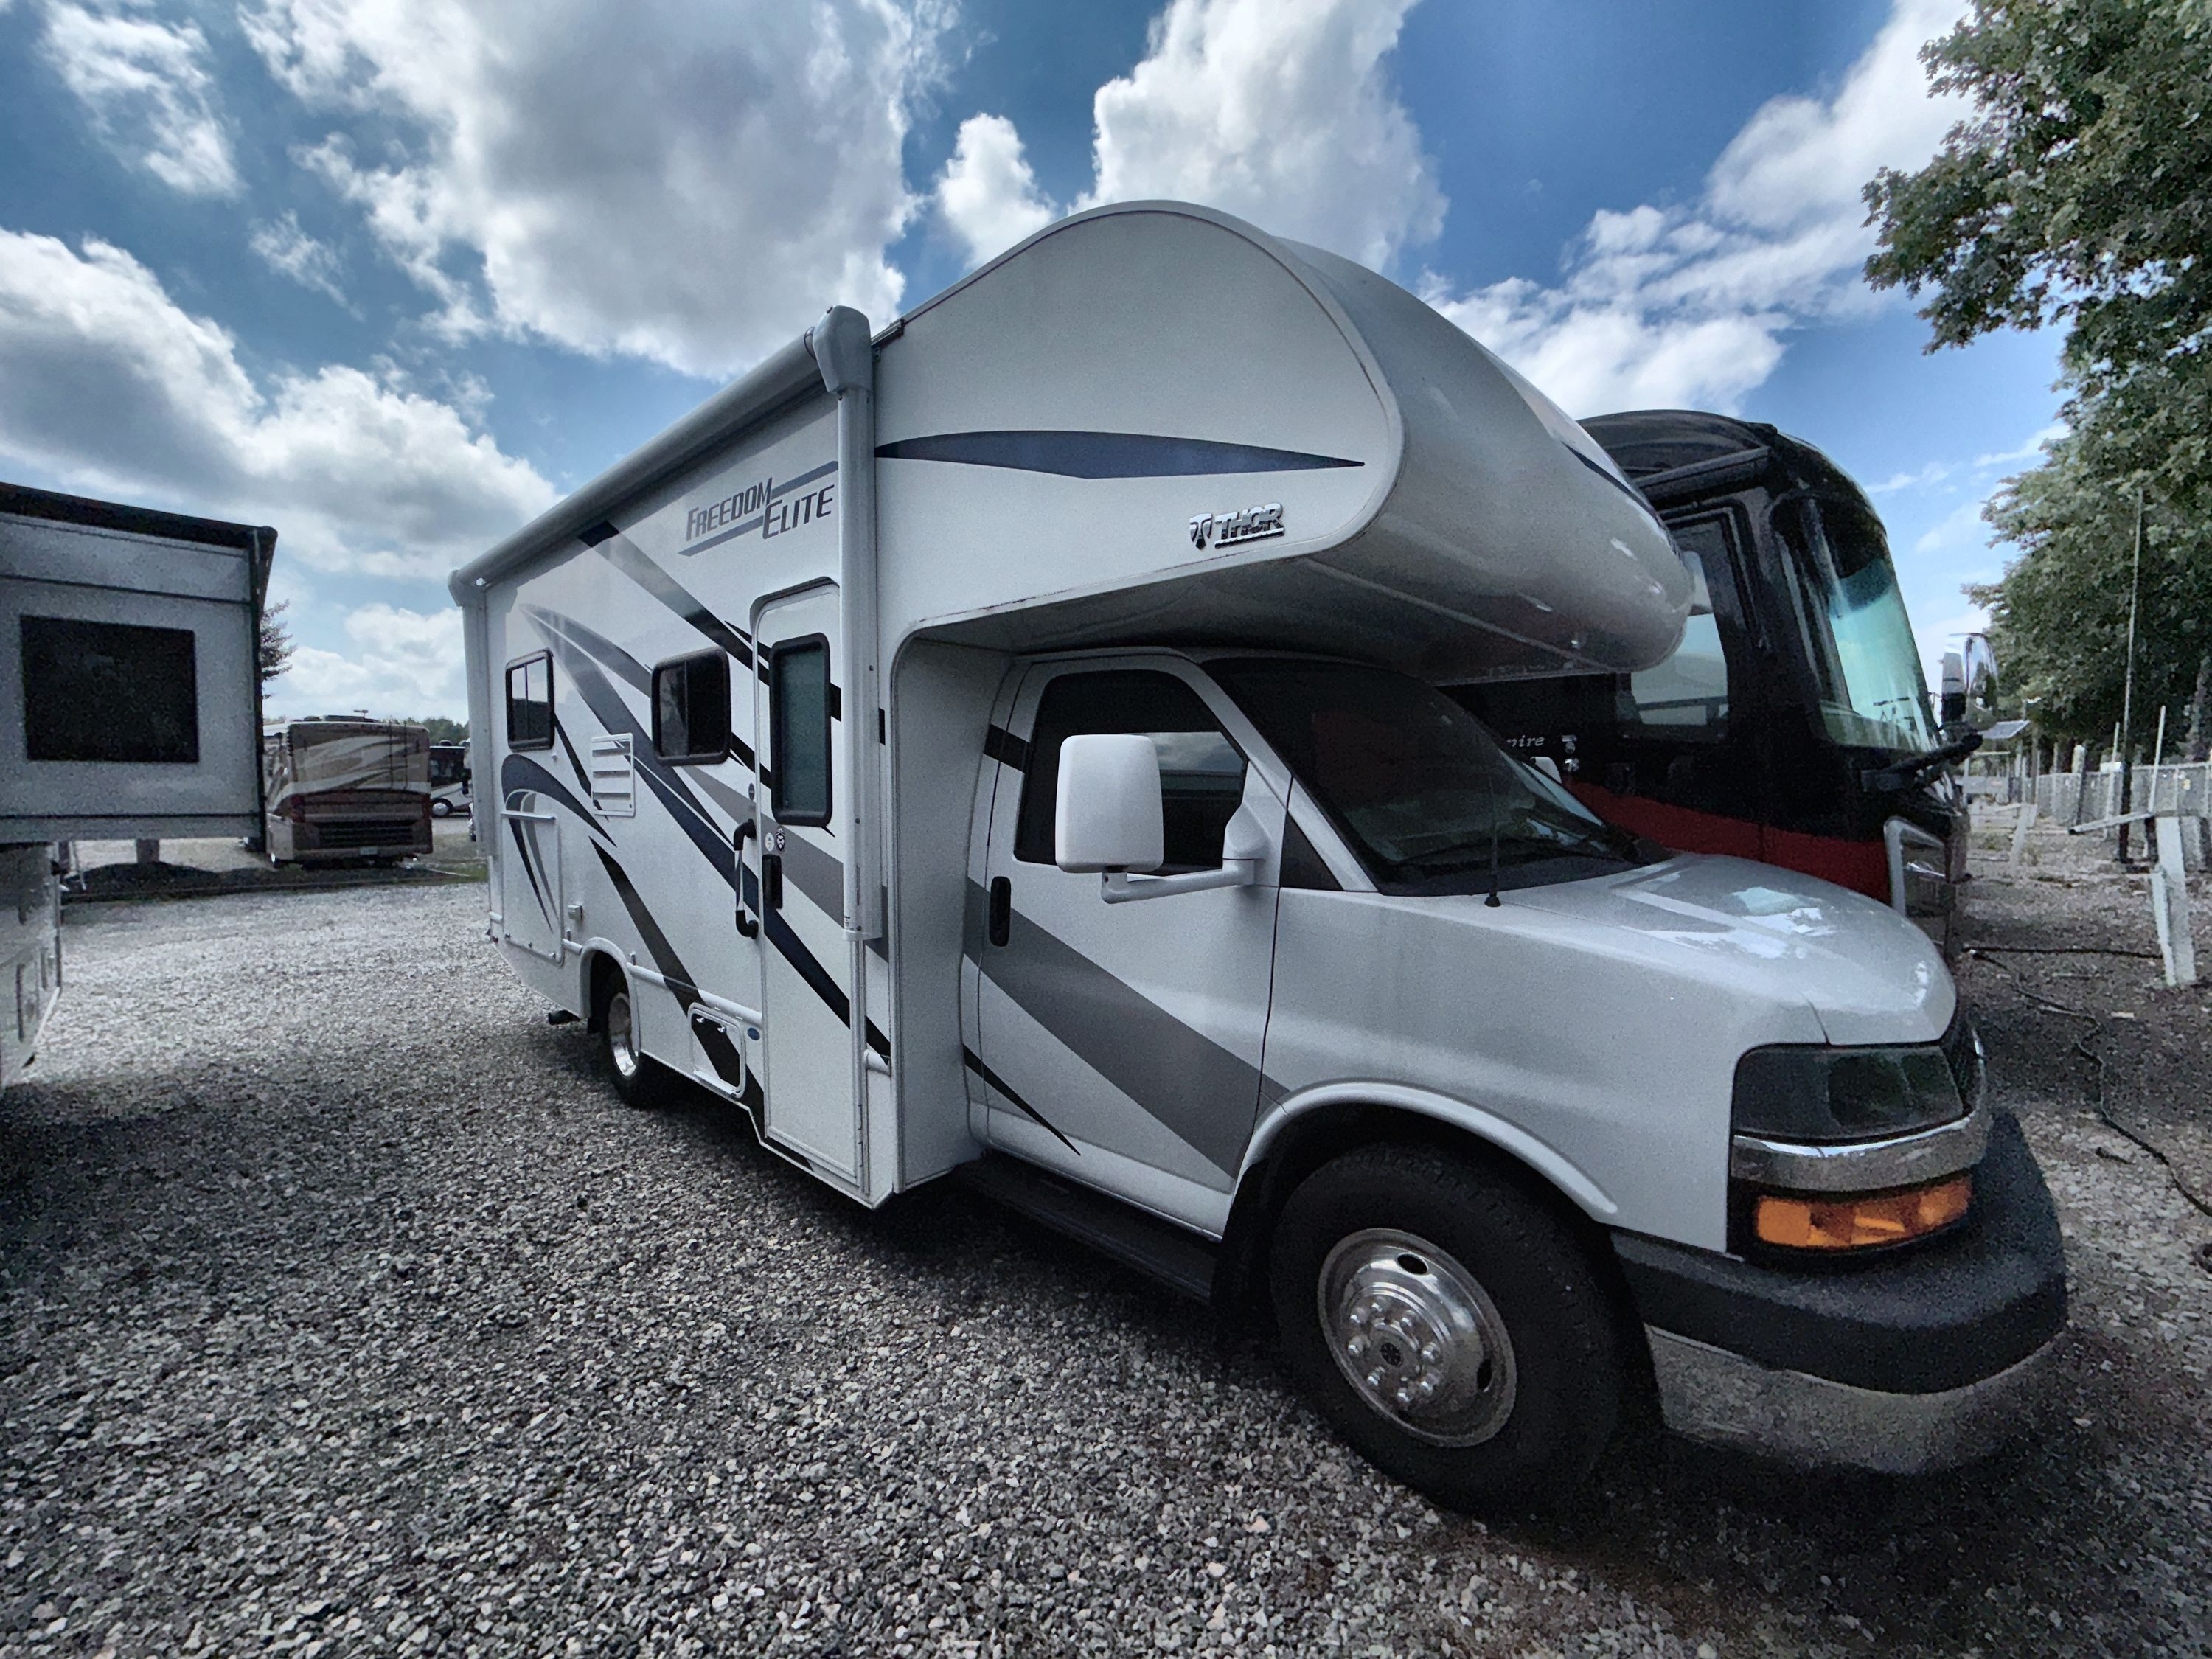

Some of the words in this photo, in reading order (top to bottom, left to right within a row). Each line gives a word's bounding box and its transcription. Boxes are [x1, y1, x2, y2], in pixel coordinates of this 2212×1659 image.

[686, 476, 773, 542] FREEDOM
[762, 484, 835, 540] ELITE
[1214, 502, 1284, 540] THOR
